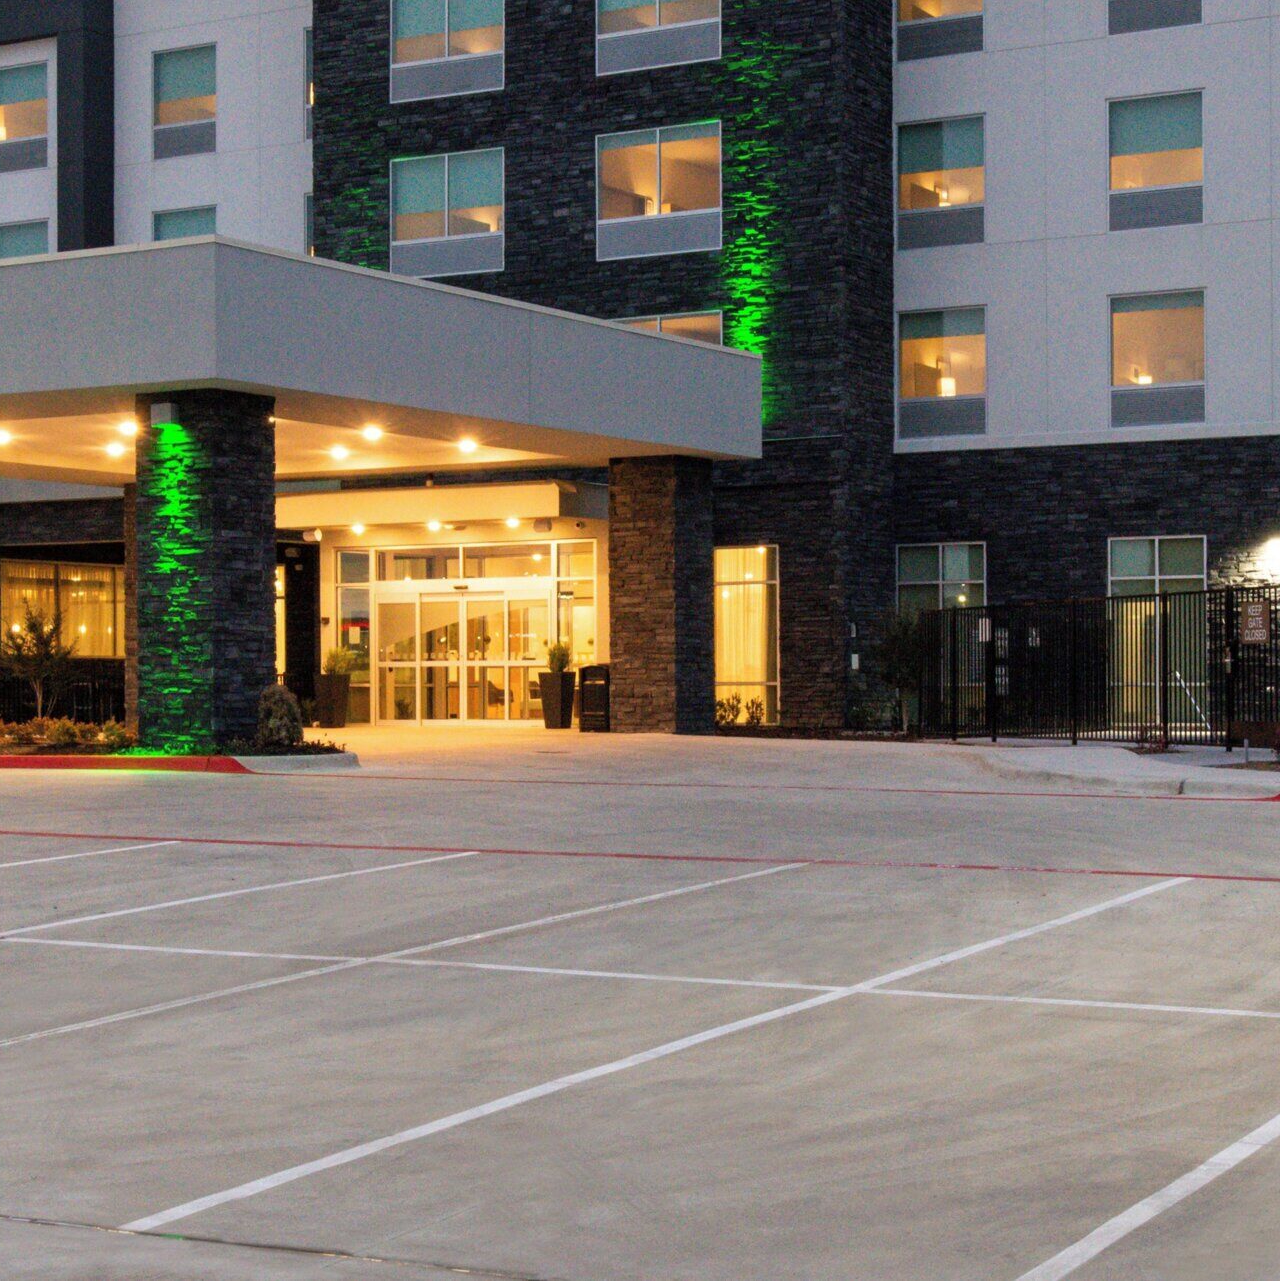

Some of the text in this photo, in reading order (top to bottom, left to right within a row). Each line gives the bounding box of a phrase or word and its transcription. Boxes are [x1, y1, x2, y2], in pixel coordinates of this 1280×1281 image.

[1248, 604, 1262, 615] KEEP
[1248, 617, 1263, 628] GATE
[1245, 629, 1267, 640] CLOSED
